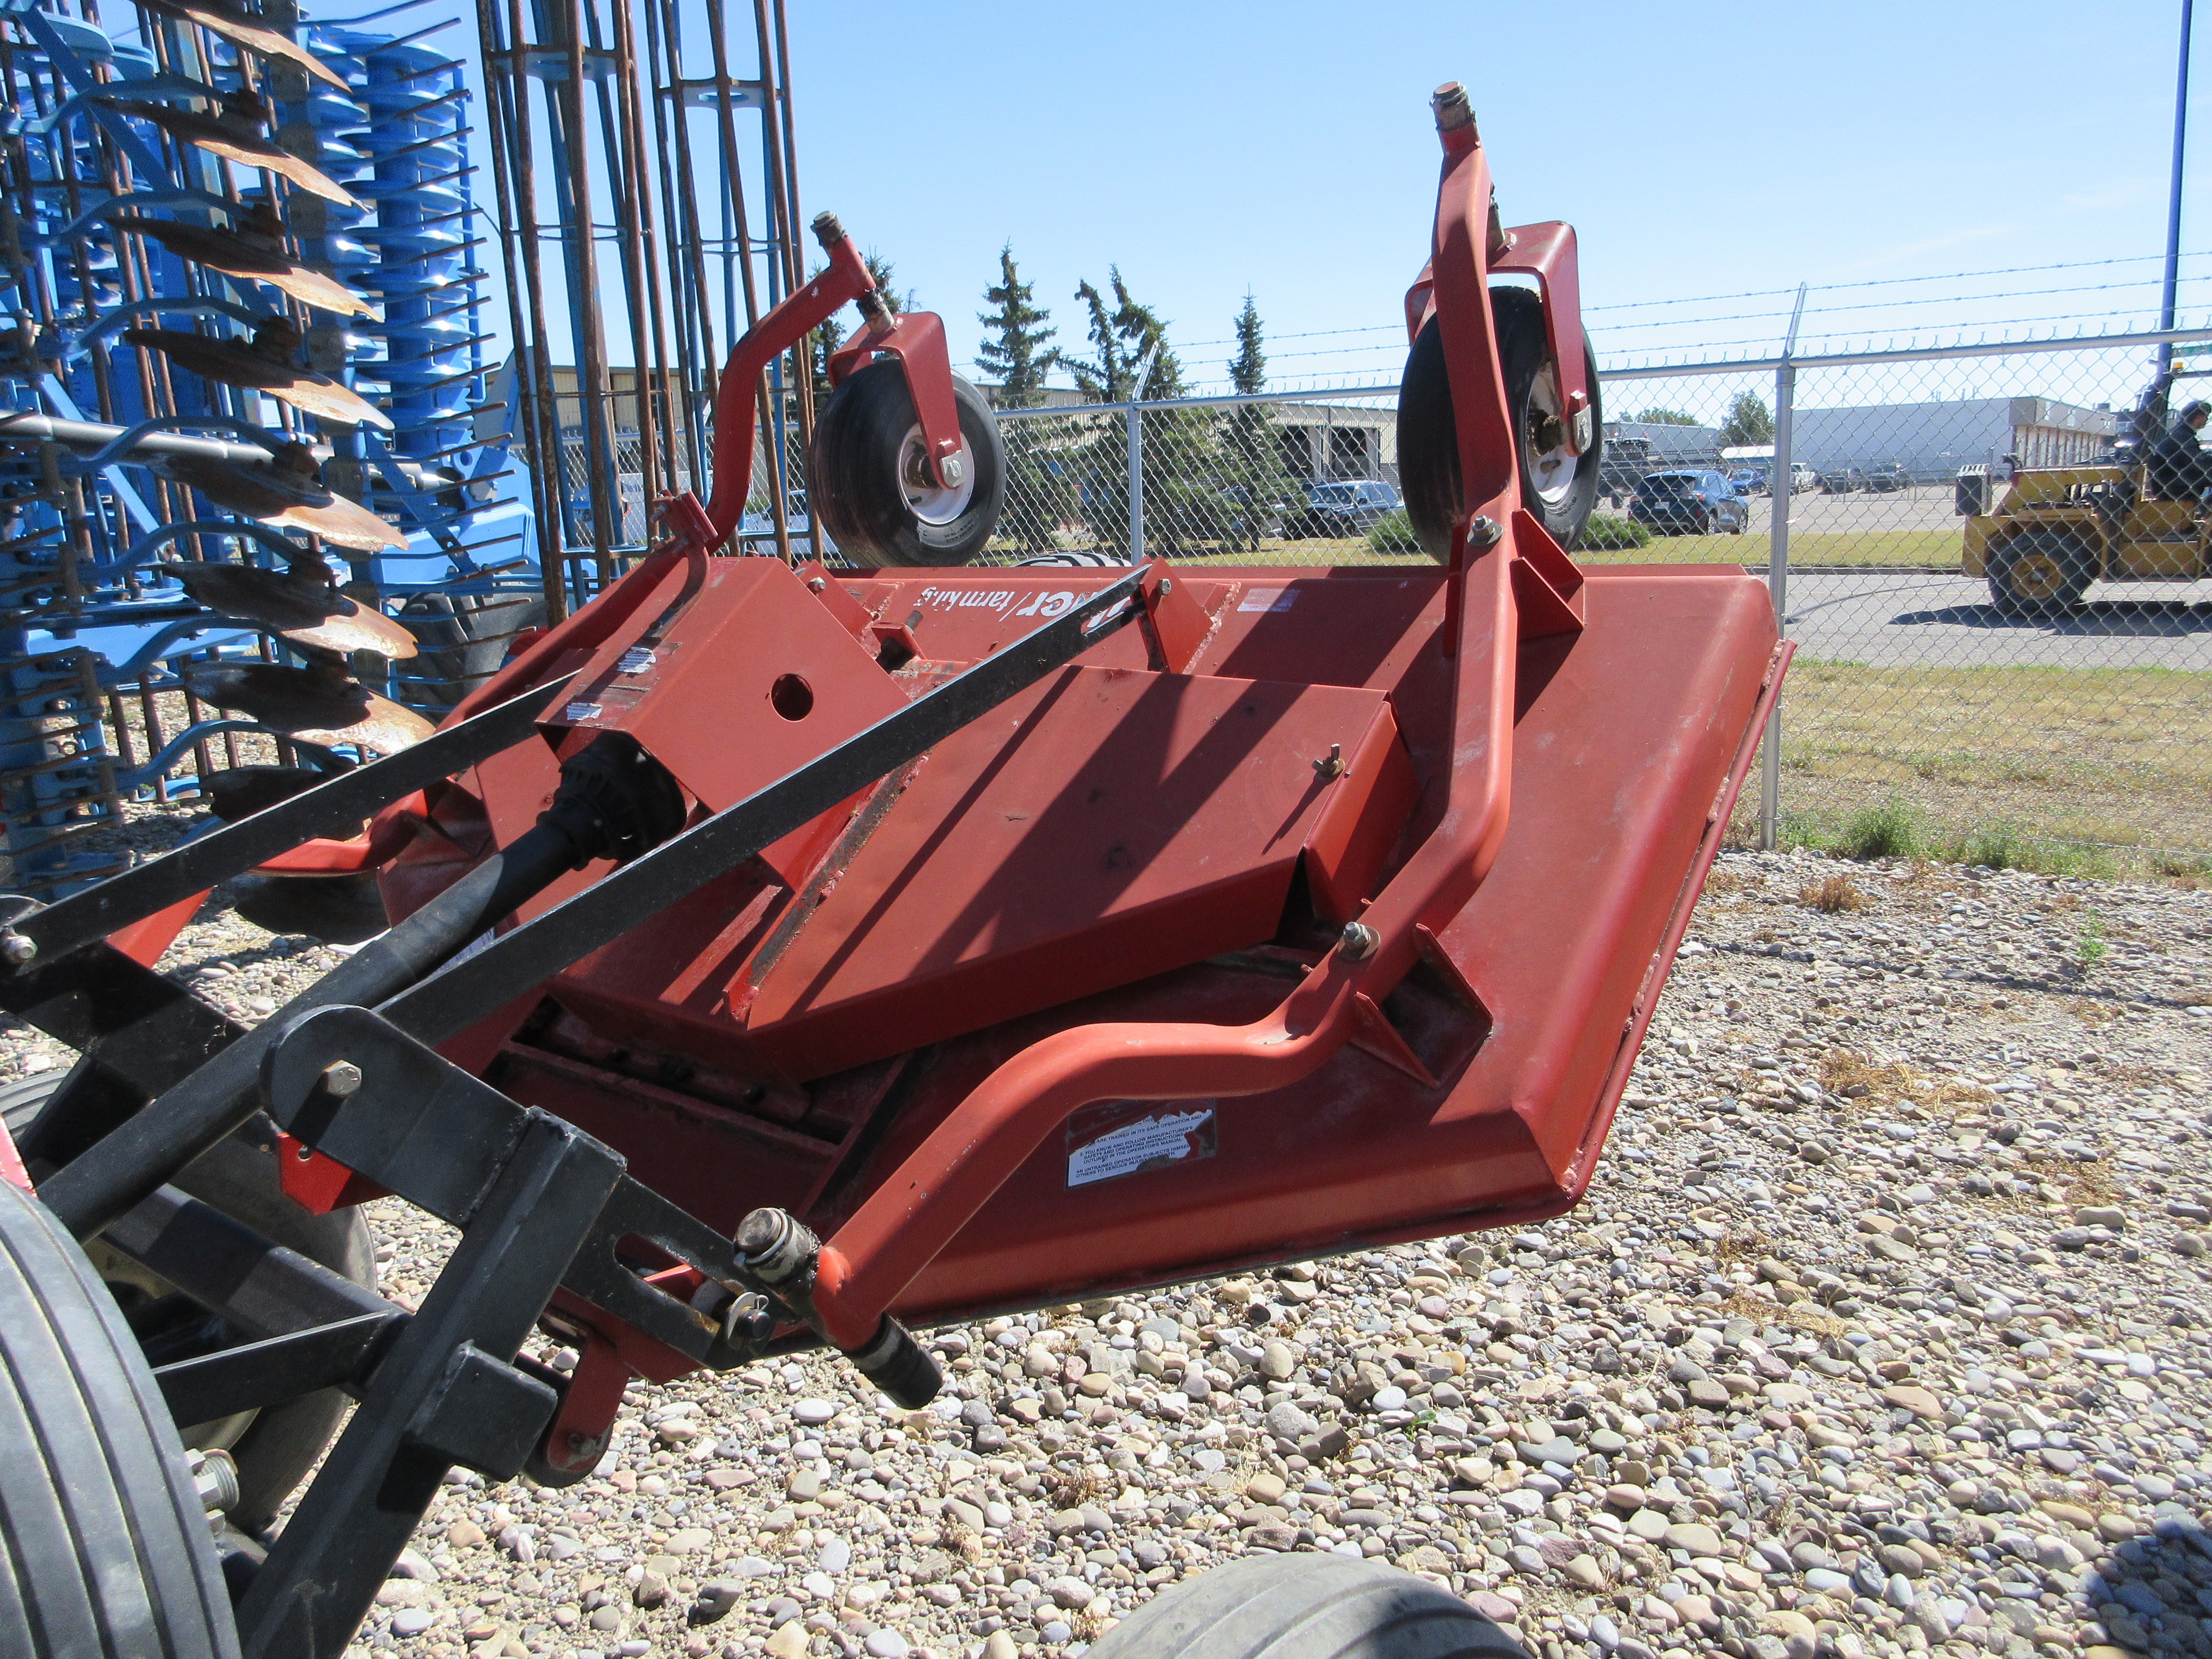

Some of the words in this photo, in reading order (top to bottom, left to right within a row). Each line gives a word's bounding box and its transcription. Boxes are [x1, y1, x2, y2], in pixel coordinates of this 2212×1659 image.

[1161, 1118, 1190, 1127] OPERATION
[1115, 1141, 1144, 1152] OPERATING
[1146, 1132, 1184, 1144] INSTRUCTIONS
[1125, 1137, 1146, 1145] FOLLOW
[1147, 1126, 1193, 1140] MANUFACTURER'S
[1084, 1155, 1108, 1164] OUTLINED
[1084, 1162, 1113, 1172] UNTRAINED
[1114, 1155, 1142, 1165] OPERATOR
[1143, 1148, 1170, 1158] SUBJECTS
[1105, 1162, 1127, 1171] SERIOUS
[1128, 1157, 1147, 1165] INJURY
